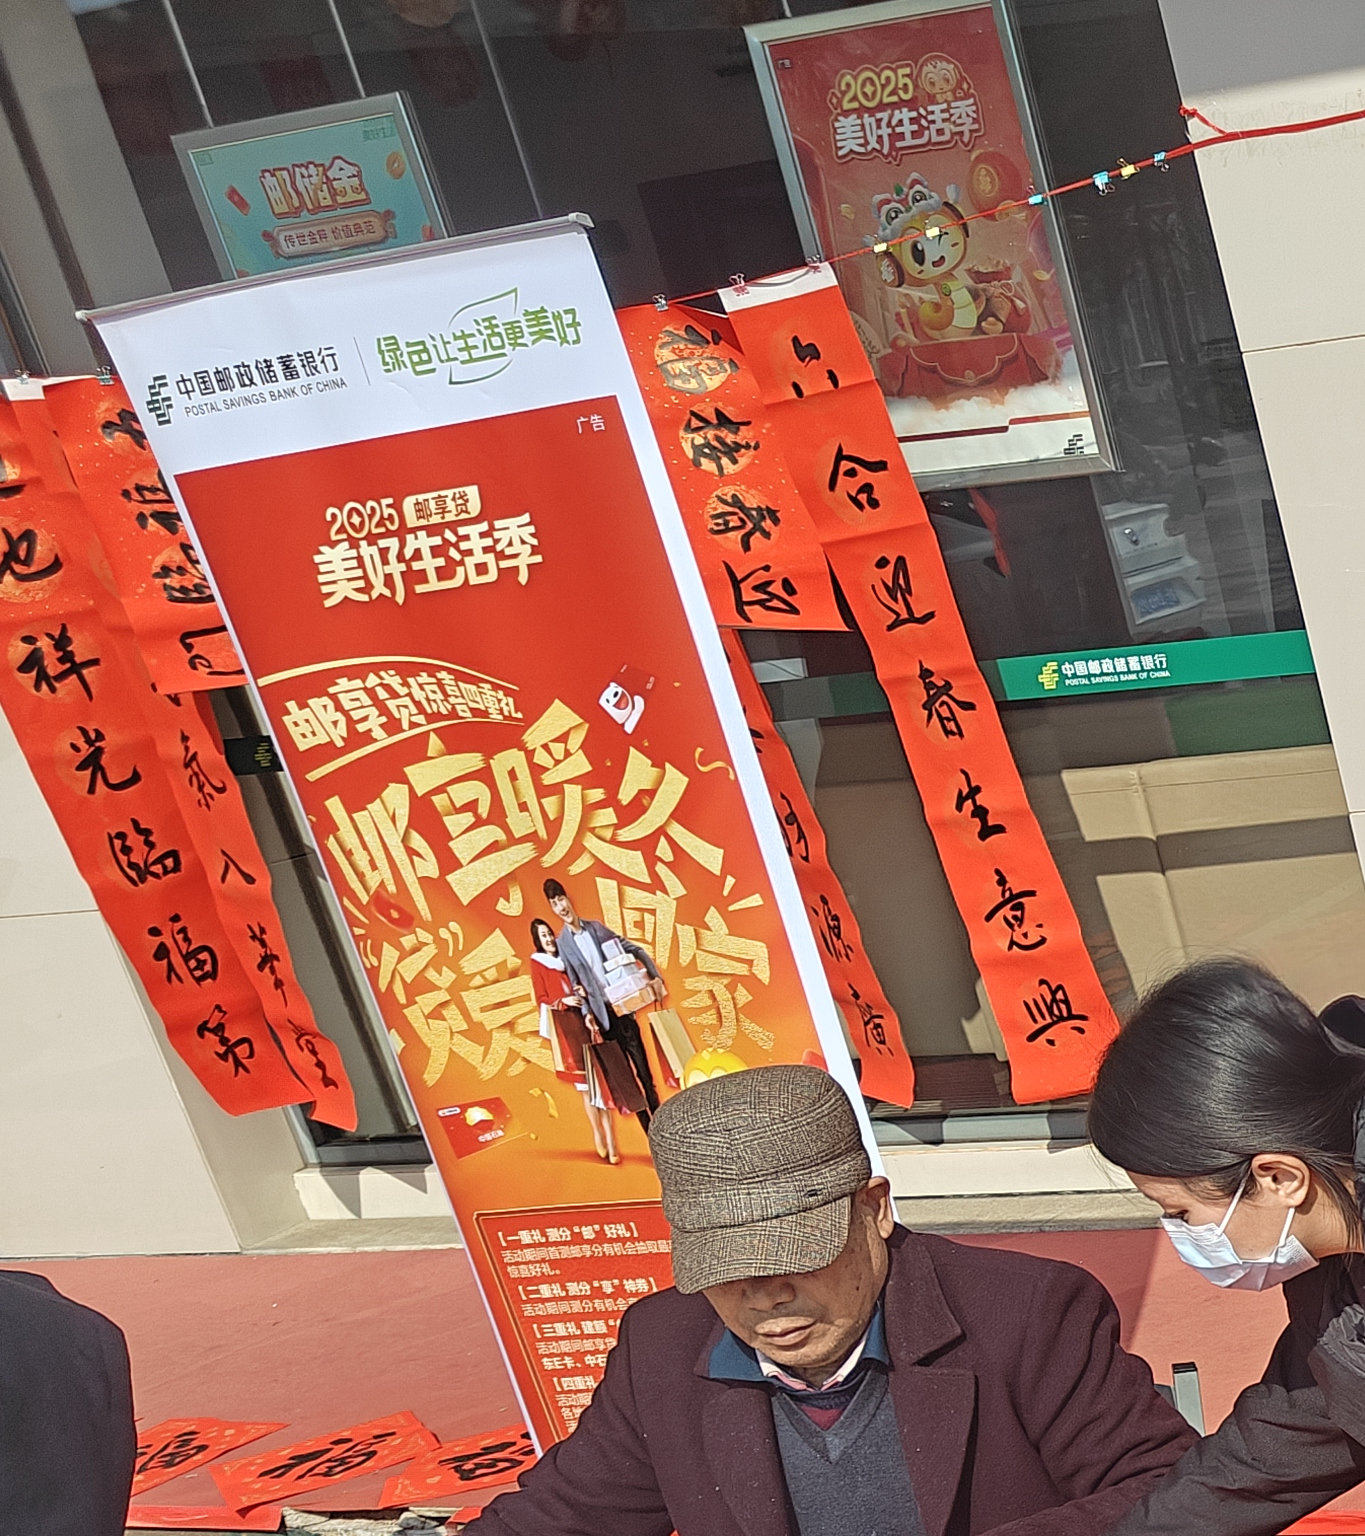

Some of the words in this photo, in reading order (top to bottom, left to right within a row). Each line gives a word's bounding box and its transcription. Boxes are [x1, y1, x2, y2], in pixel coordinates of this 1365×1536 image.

[840, 67, 914, 110] 2025
[834, 97, 979, 156] 美好生活季
[261, 158, 370, 217] 邮储金
[376, 306, 582, 377] 绿色让生活更美好
[175, 345, 340, 402] 中国邮政储蓄银行
[184, 402, 223, 418] POSTAL
[222, 394, 267, 412] SAVINGS
[268, 385, 300, 405] BANK
[300, 383, 315, 397] OF
[315, 376, 348, 393] CHINA
[576, 413, 606, 434] 广告
[325, 496, 400, 541] 2025
[412, 490, 471, 527] 邮享贷
[313, 512, 544, 609] 美好生活季
[1061, 654, 1167, 677] 中国邮政储蓄银行
[1065, 678, 1090, 686] POSTAL
[1091, 675, 1119, 684] SAVINGS
[1120, 673, 1138, 681] BANK
[1149, 670, 1171, 678] CHINA
[282, 669, 523, 753] 邮享贷惊喜四重礼
[257, 1431, 397, 1481] 福
